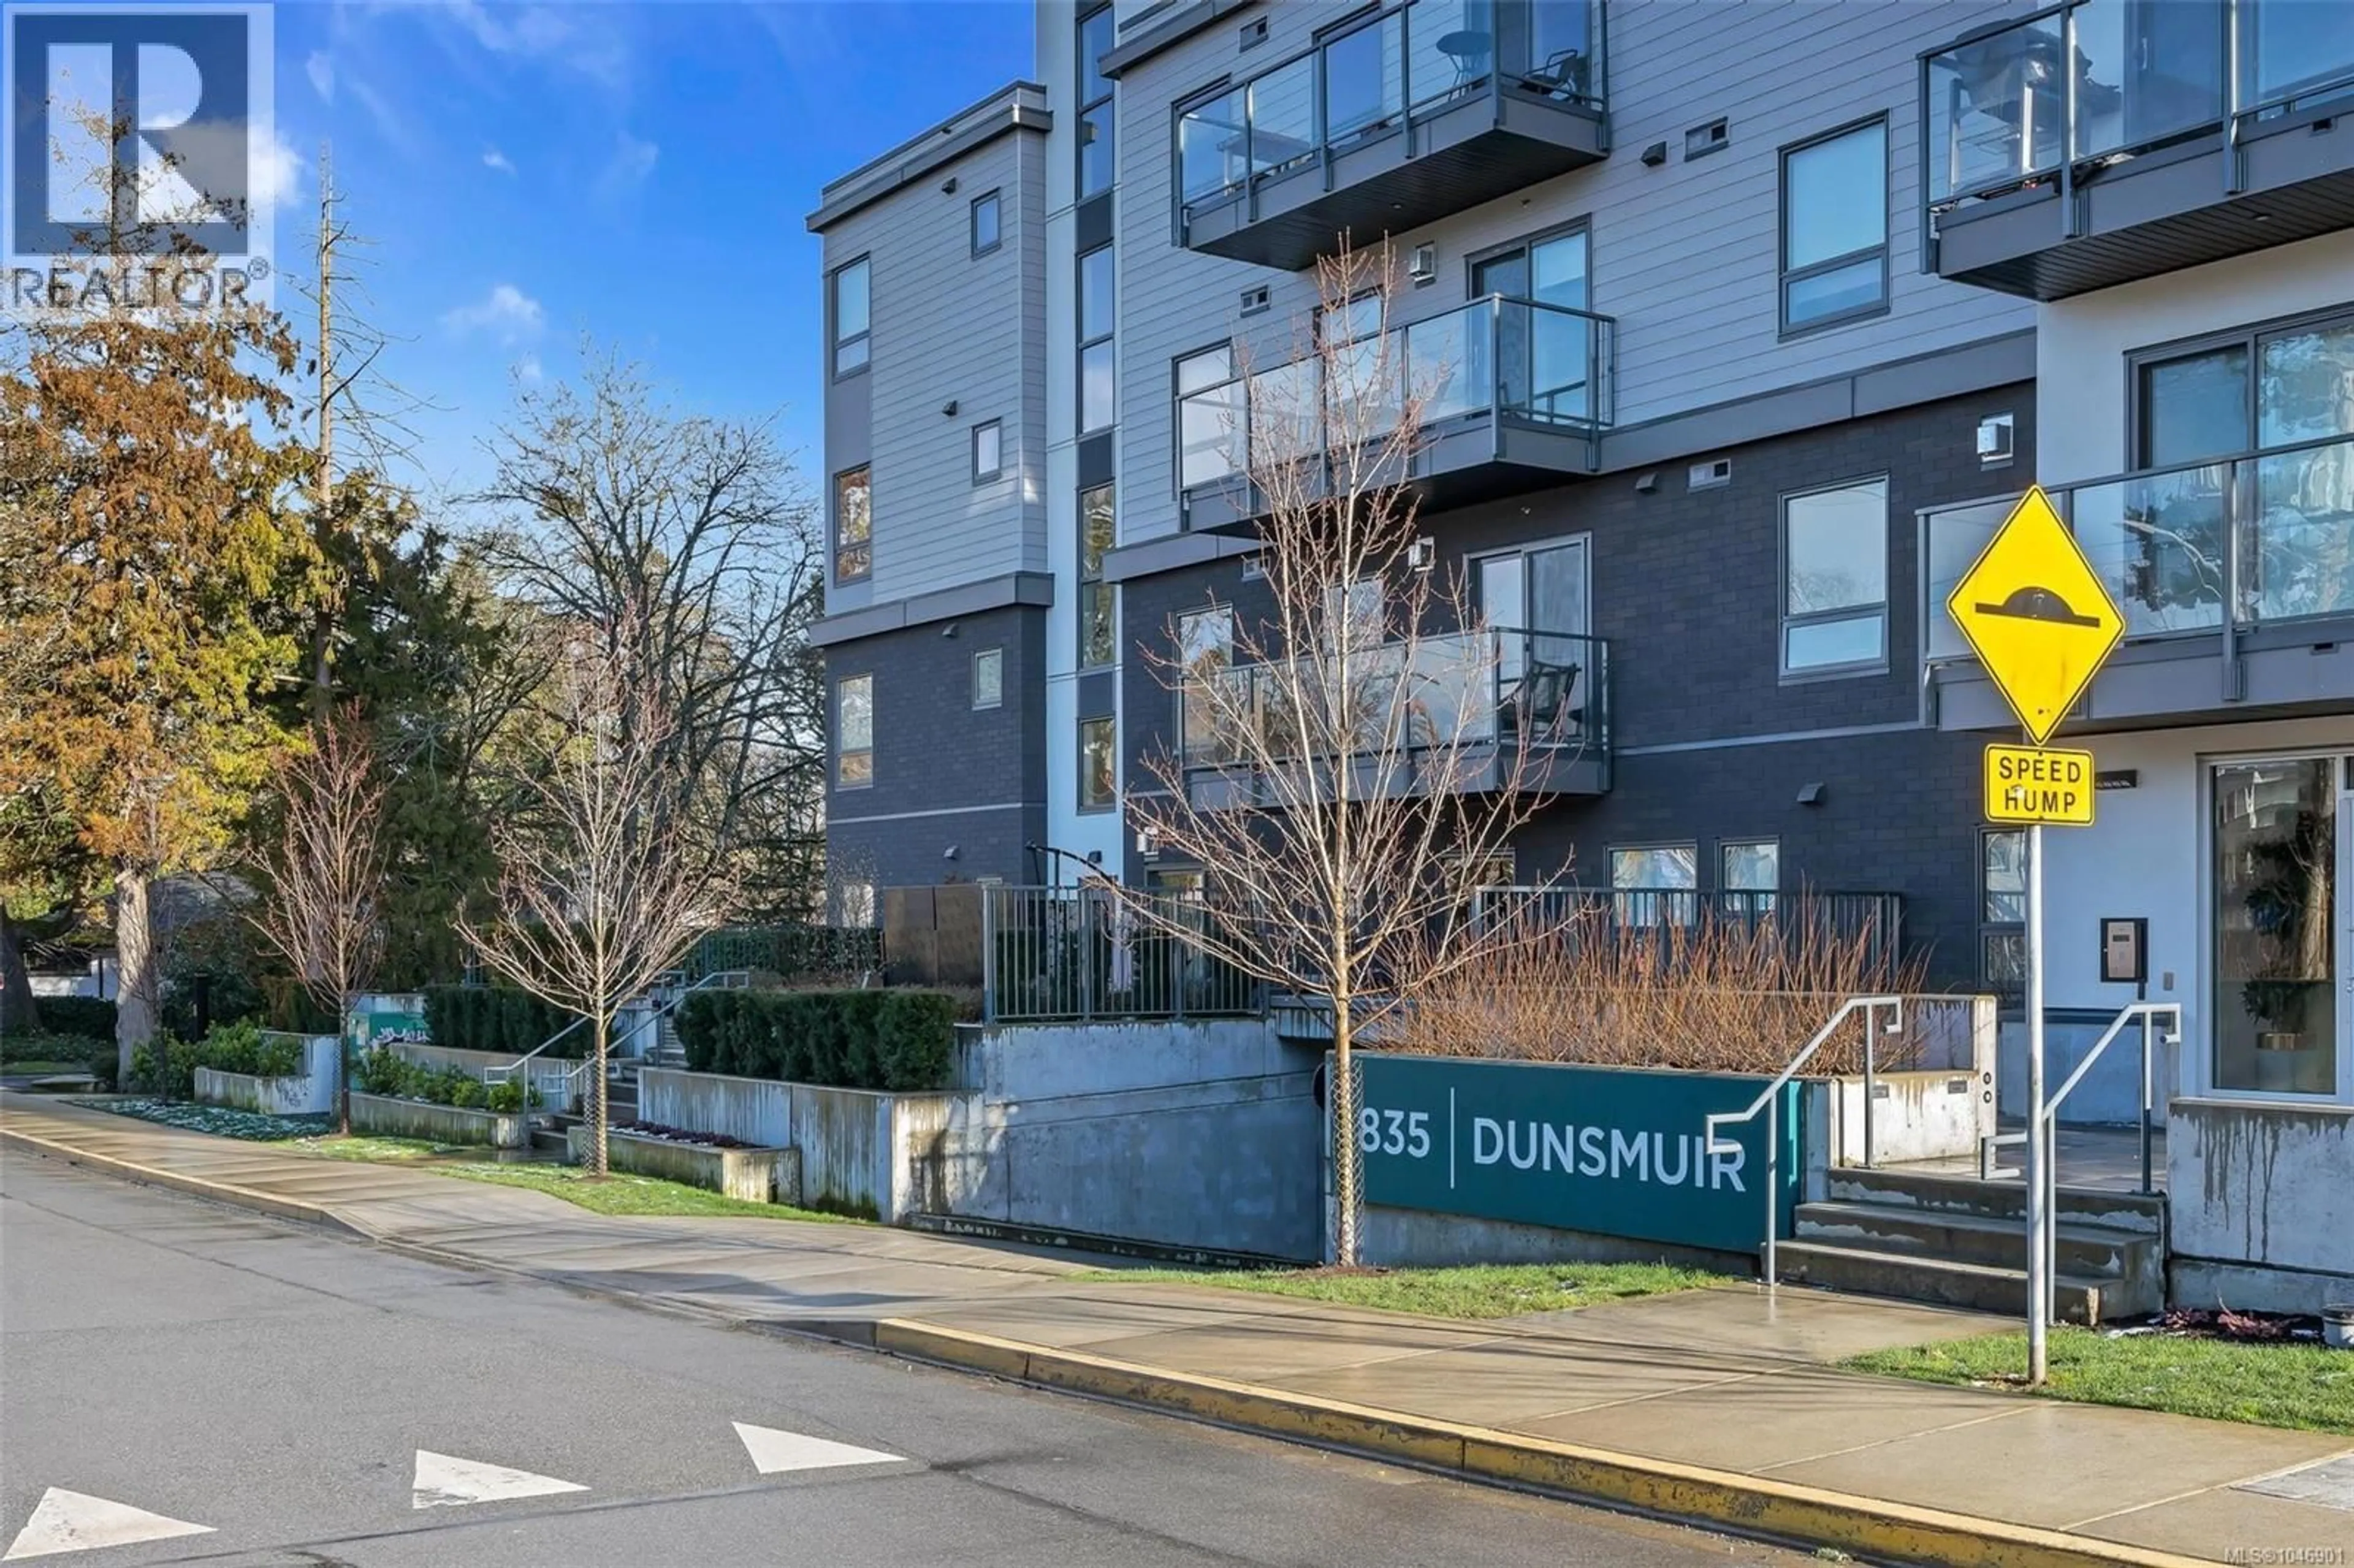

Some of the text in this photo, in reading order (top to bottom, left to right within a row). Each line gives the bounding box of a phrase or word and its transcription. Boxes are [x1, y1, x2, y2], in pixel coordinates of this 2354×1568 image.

[1999, 756, 2081, 783] SPEED
[2005, 788, 2076, 813] HUMP
[1358, 1107, 1746, 1192] 835 DUNSMUIR
